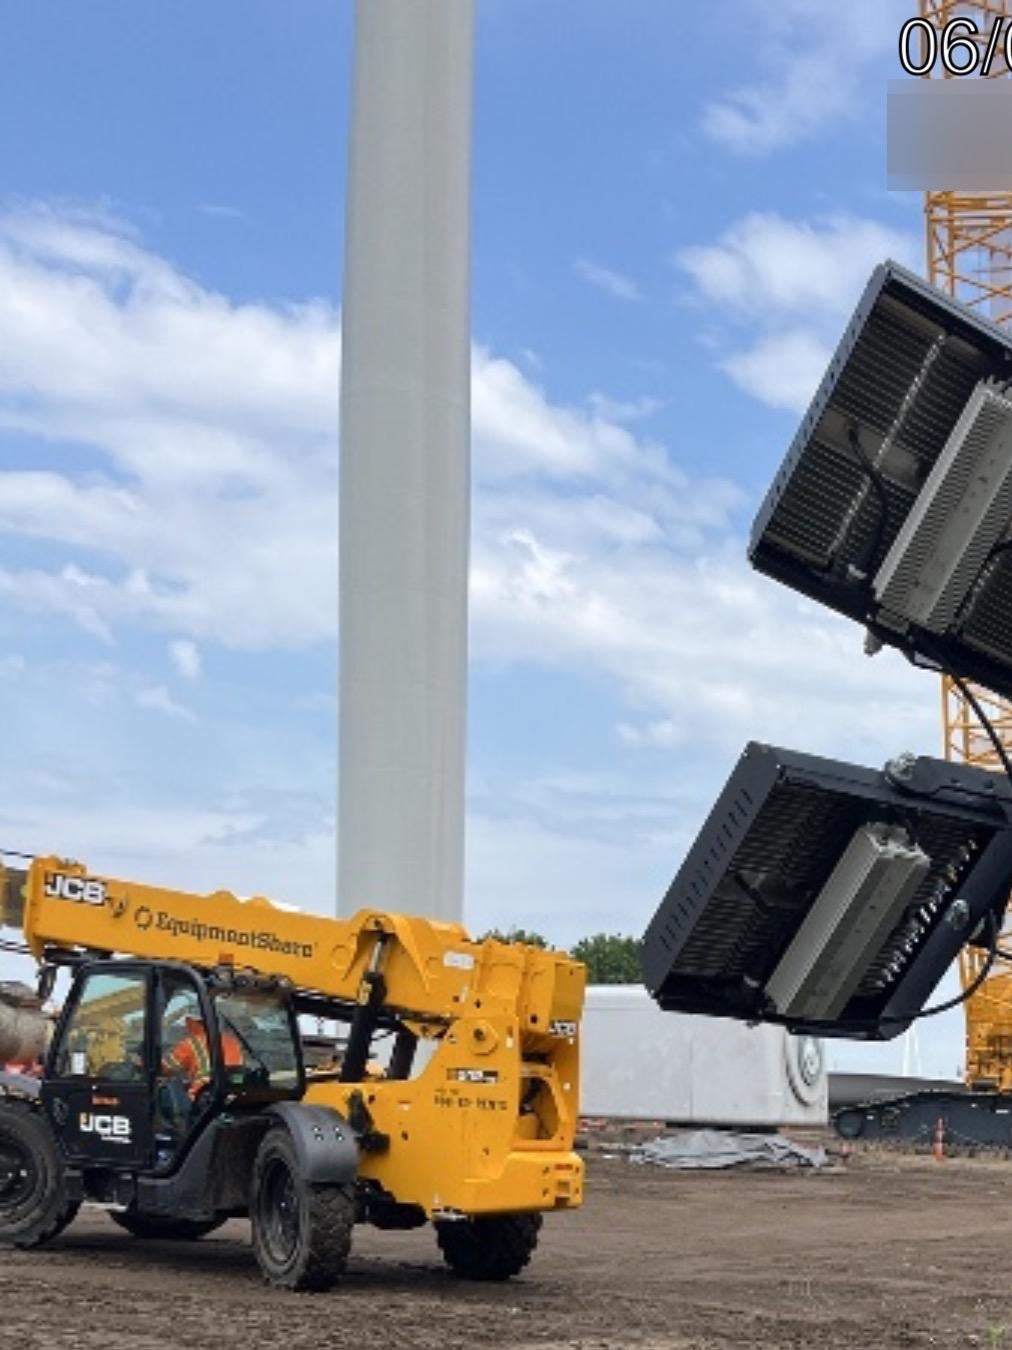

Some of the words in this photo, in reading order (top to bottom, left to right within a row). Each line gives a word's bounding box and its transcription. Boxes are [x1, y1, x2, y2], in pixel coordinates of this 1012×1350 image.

[45, 876, 105, 903] JCB
[155, 911, 313, 957] EquipmentShare
[79, 1111, 131, 1135] JCB
